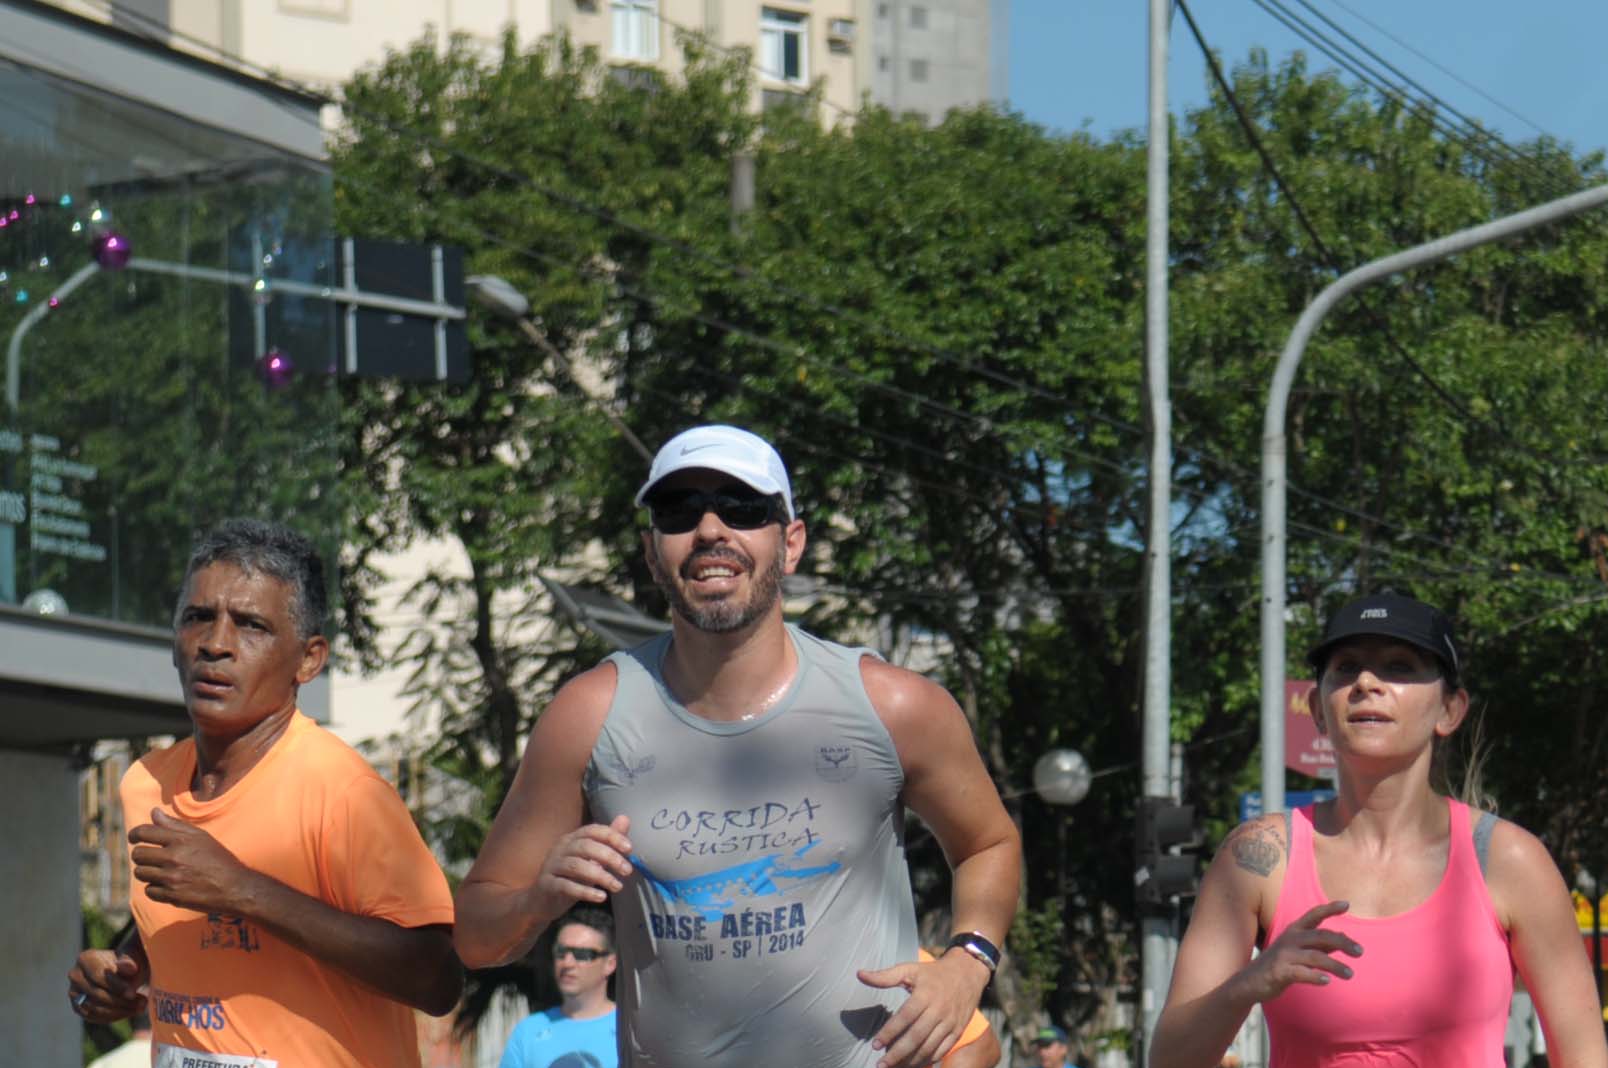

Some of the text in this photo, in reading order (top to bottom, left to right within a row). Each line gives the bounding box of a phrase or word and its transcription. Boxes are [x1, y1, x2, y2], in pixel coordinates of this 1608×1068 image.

[650, 797, 822, 837] CORRIDA
[675, 827, 819, 860] RUSTICA
[651, 912, 707, 941] BASE
[719, 901, 807, 939] AÉREA
[732, 941, 753, 959] SP
[769, 932, 804, 953] 2014
